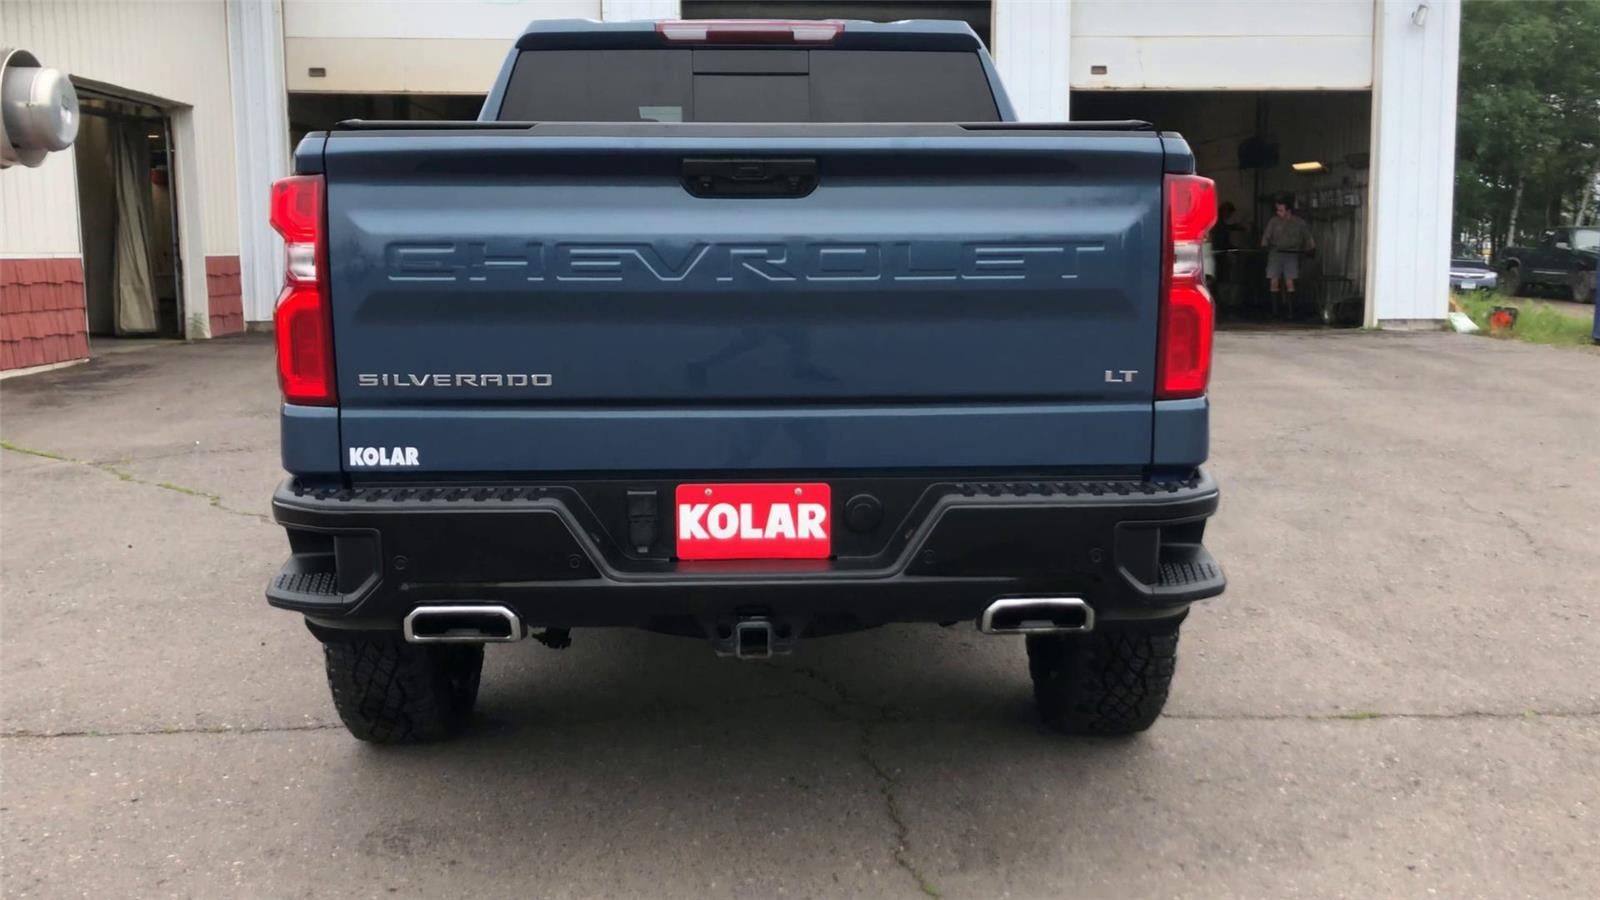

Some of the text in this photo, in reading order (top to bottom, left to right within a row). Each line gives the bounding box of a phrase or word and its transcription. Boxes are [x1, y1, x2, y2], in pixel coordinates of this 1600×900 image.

[385, 241, 1106, 282] CHEVROLET
[358, 373, 553, 387] SILVERADO
[1104, 370, 1138, 382] LT
[348, 447, 420, 466] KOLAR
[678, 503, 827, 540] KOLAR
